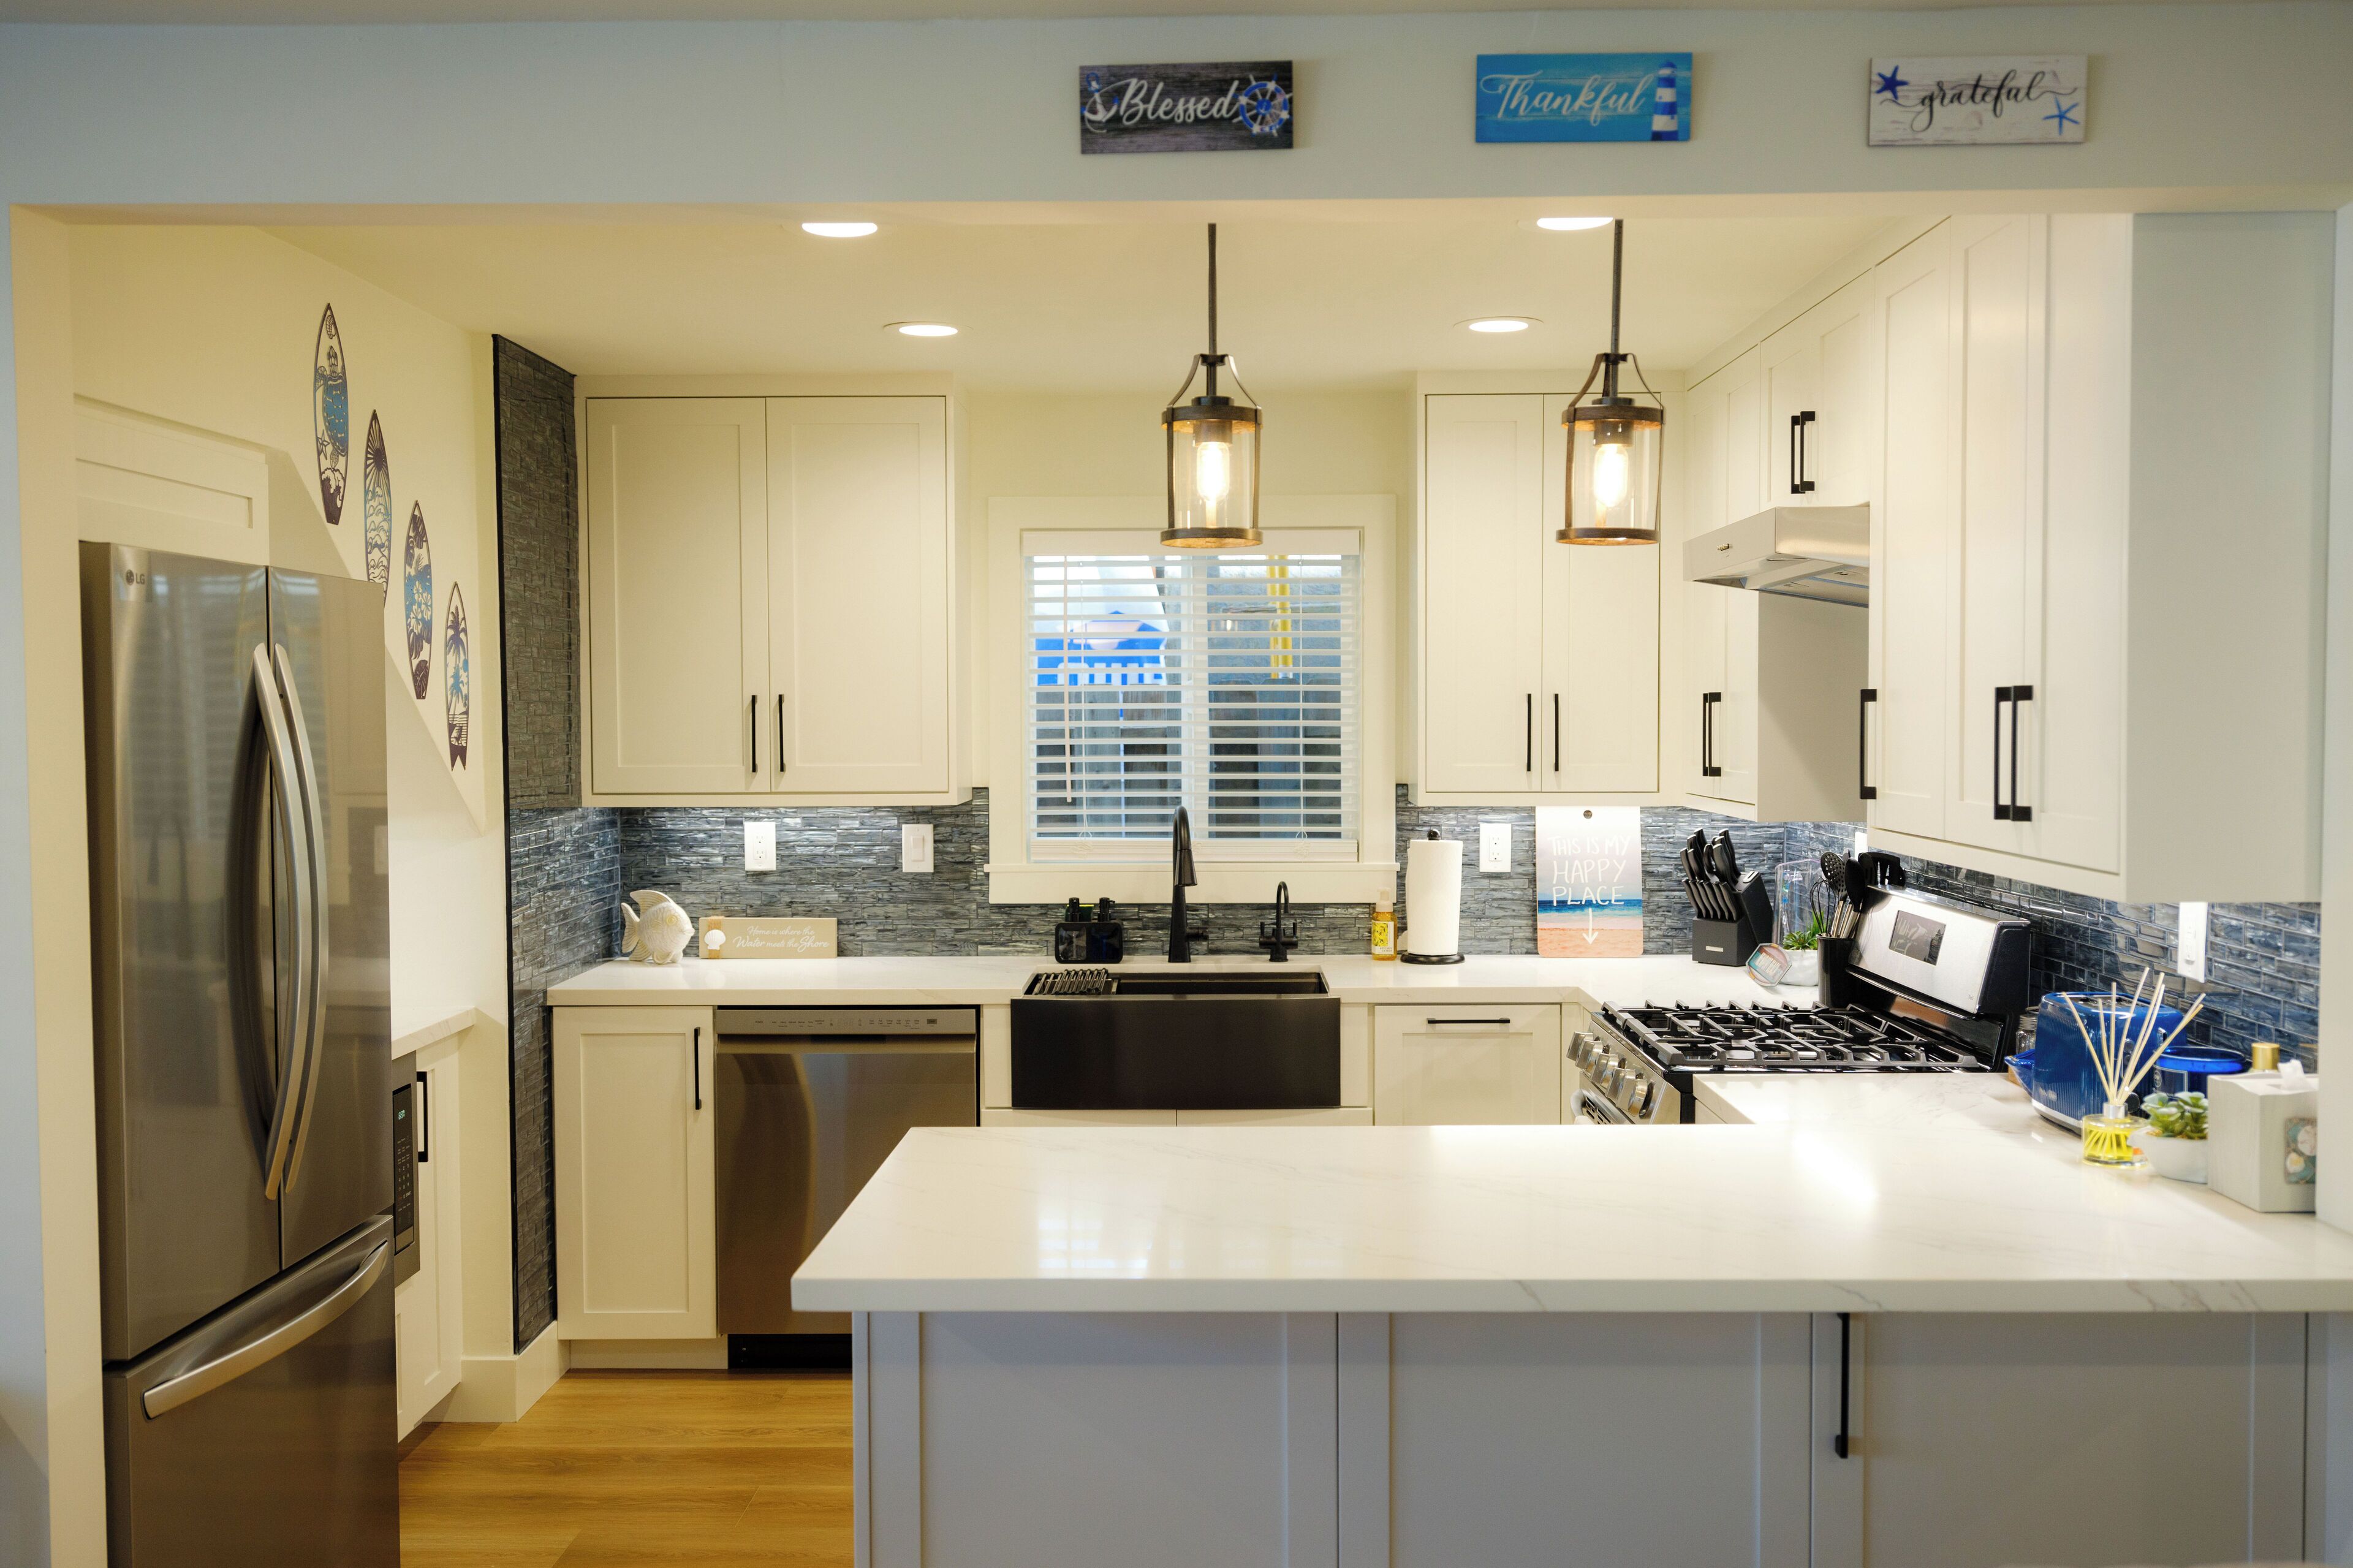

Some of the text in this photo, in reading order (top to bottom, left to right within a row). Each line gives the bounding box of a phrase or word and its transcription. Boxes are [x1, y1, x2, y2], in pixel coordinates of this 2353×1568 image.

[1086, 78, 1240, 132] Blessed
[1480, 69, 1654, 126] Thankful
[1881, 69, 2078, 132] grateful
[1547, 835, 1631, 856] THIS IS MY
[1553, 858, 1627, 884] HAPPY
[1553, 886, 1624, 906] PLACE
[746, 926, 771, 936] Home
[779, 926, 802, 935] where
[802, 926, 816, 936] the
[733, 936, 765, 948] Water
[786, 938, 800, 948] the
[797, 936, 830, 952] Shore
